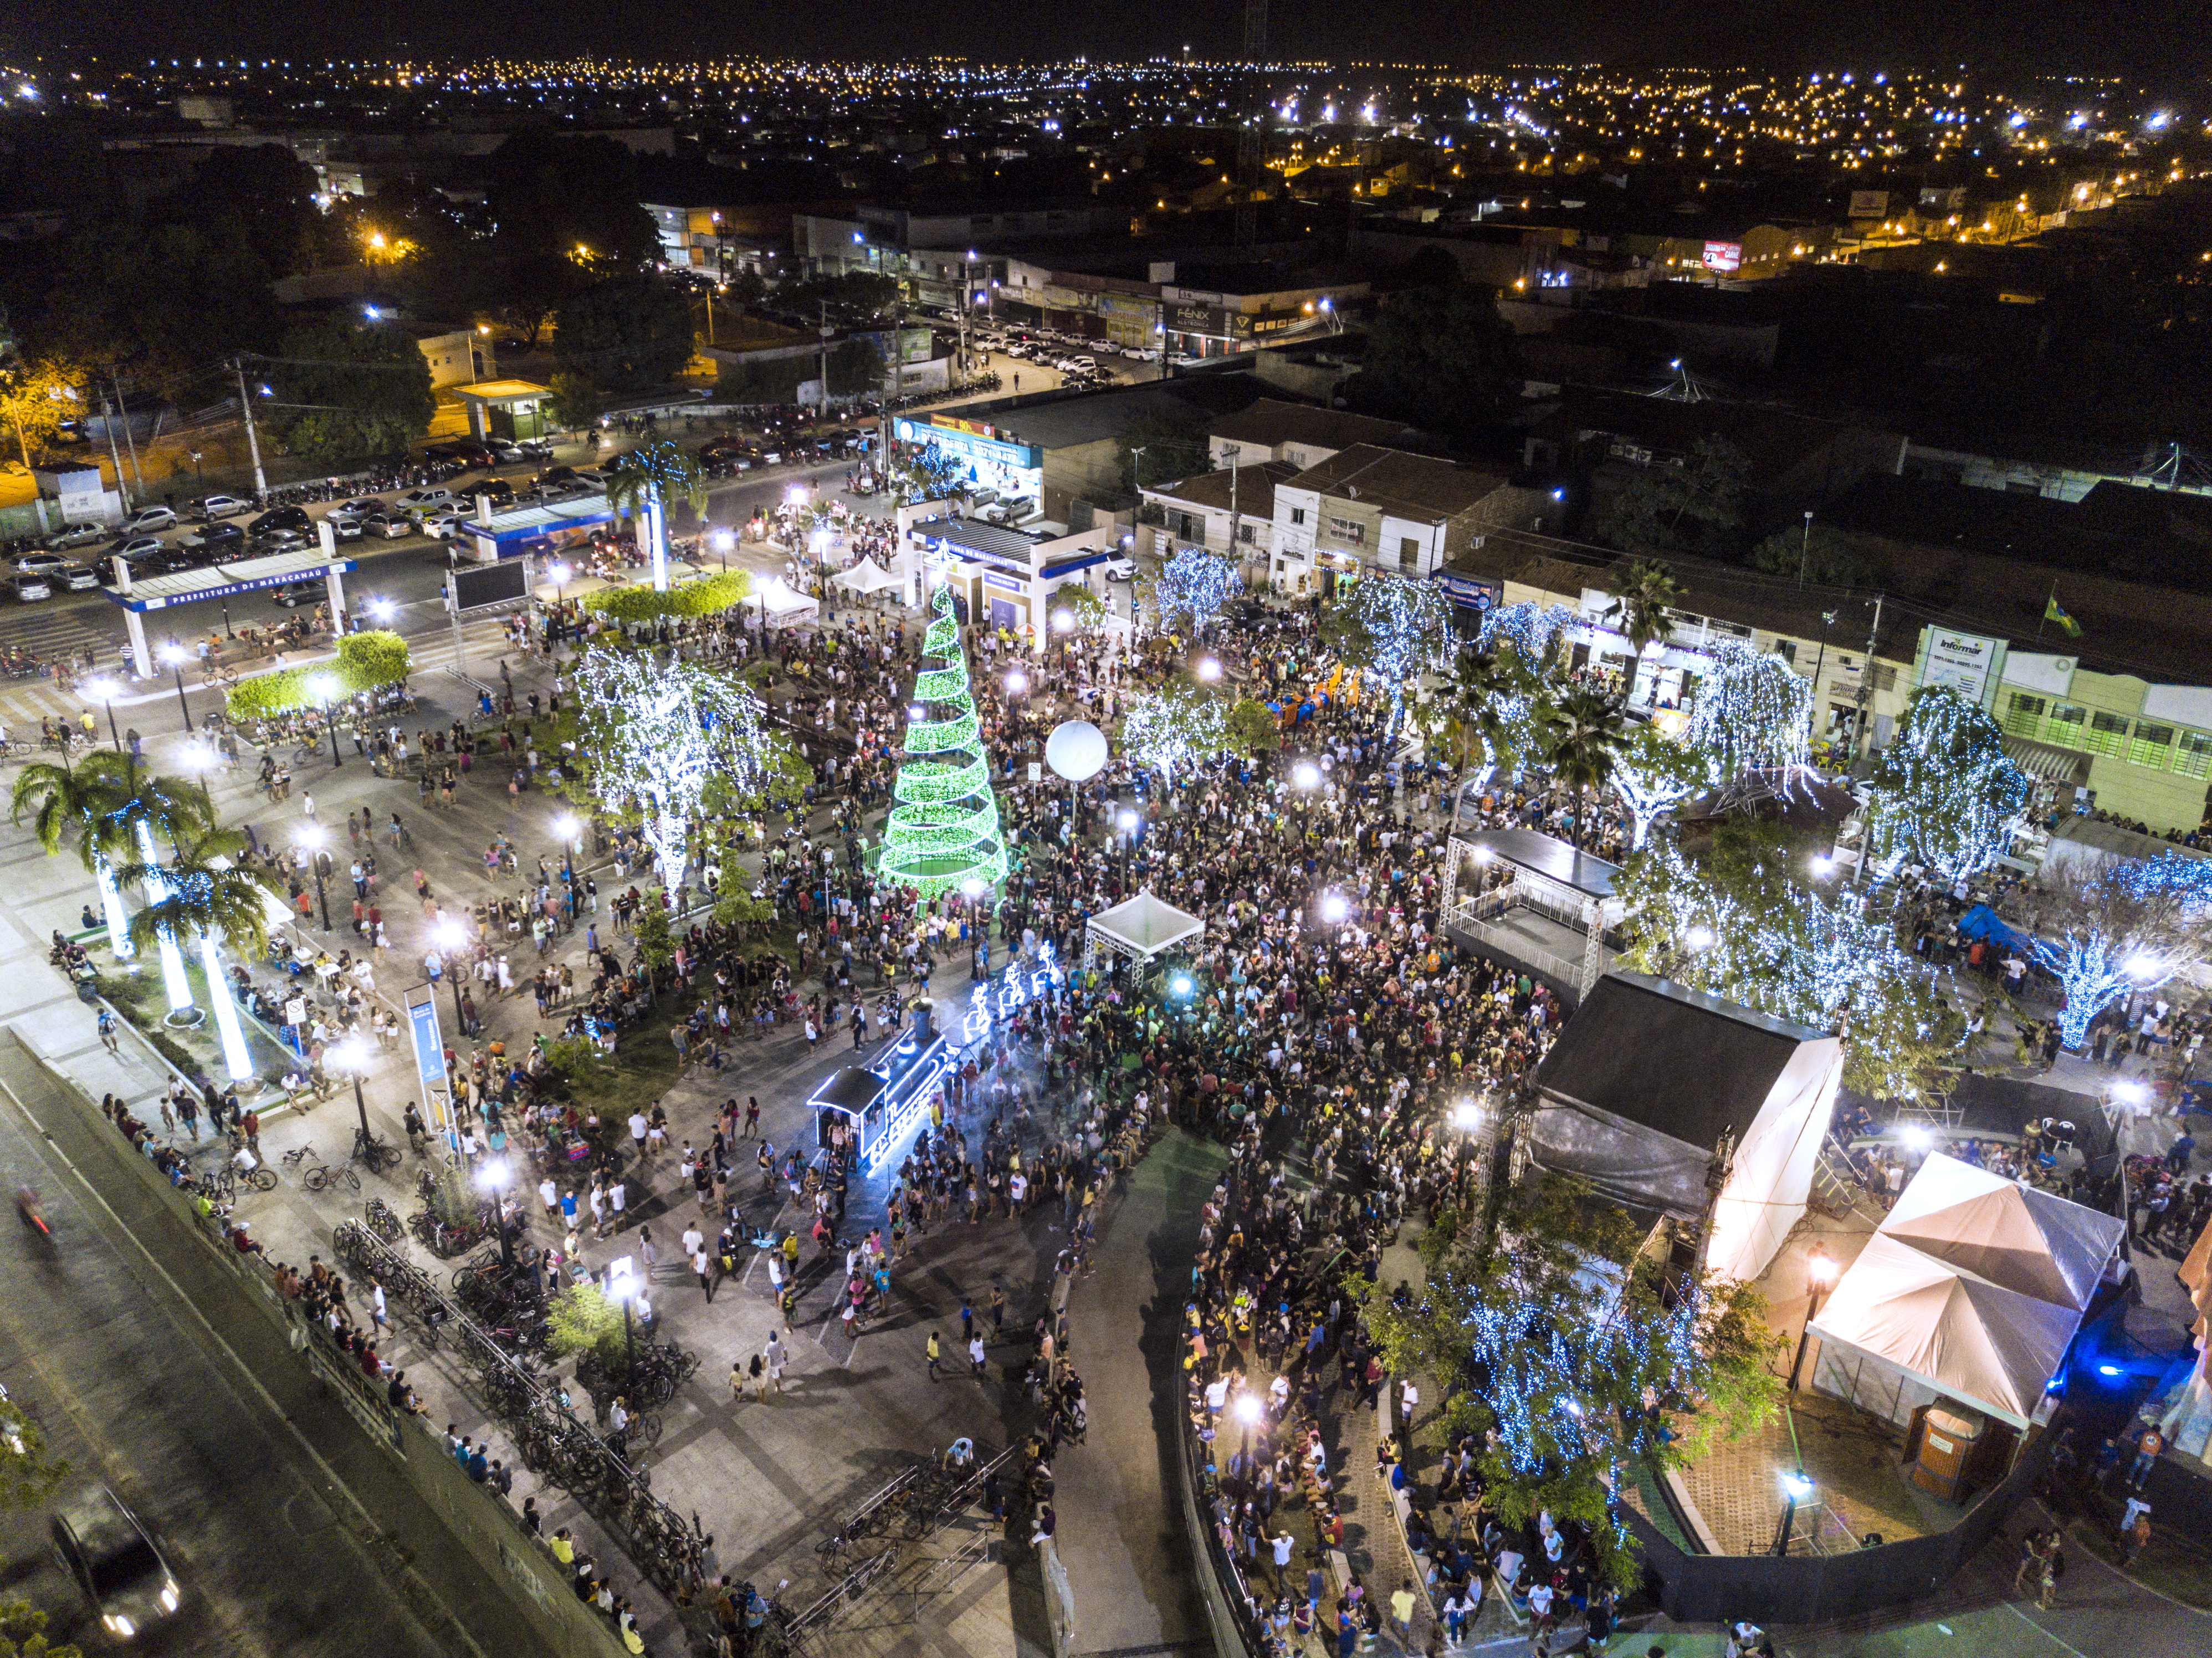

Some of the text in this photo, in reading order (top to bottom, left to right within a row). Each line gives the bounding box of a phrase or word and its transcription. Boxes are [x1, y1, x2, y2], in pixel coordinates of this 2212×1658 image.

[1724, 250, 1739, 259] CARNE
[1177, 306, 1209, 321] FÊNIX
[921, 432, 970, 452] DOSE CERTA
[935, 540, 964, 554] PRITURA
[974, 551, 1008, 566] MARACANAÚ
[173, 569, 322, 603] PREFEITURA DE MARACANAÚ
[1002, 579, 1016, 587] MILITAR
[1940, 639, 1982, 655] Informar
[1683, 654, 1702, 665] Pense
